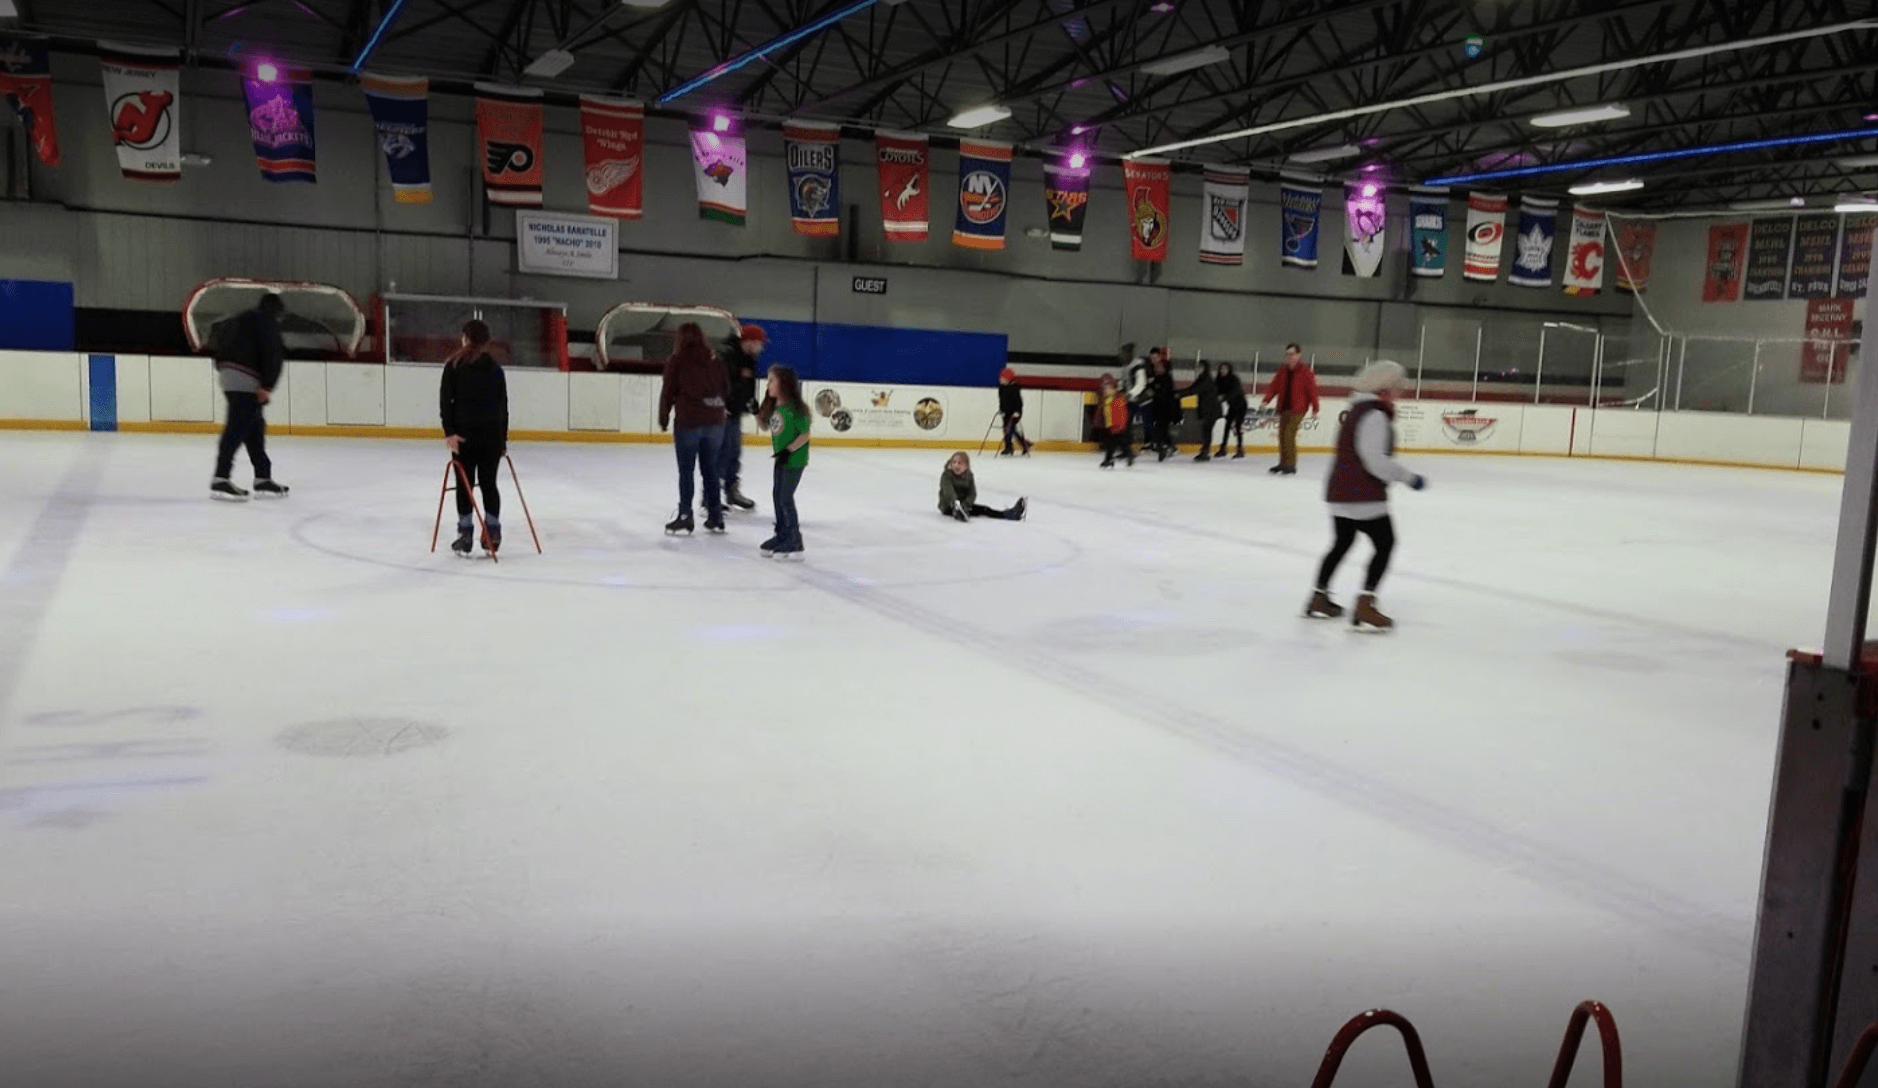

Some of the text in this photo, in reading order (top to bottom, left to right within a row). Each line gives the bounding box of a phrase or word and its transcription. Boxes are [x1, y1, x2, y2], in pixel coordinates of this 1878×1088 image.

[585, 125, 618, 138] Detroit
[597, 138, 627, 151] Wings
[788, 144, 834, 172] OILERS
[879, 148, 925, 164] COYOTES
[145, 161, 175, 169] DEVILS
[1125, 168, 1168, 180] SENATORS
[1046, 189, 1087, 205] STARS
[529, 223, 565, 234] NICHOLAS
[1799, 219, 1837, 231] DELCO
[854, 278, 885, 292] GUEST
